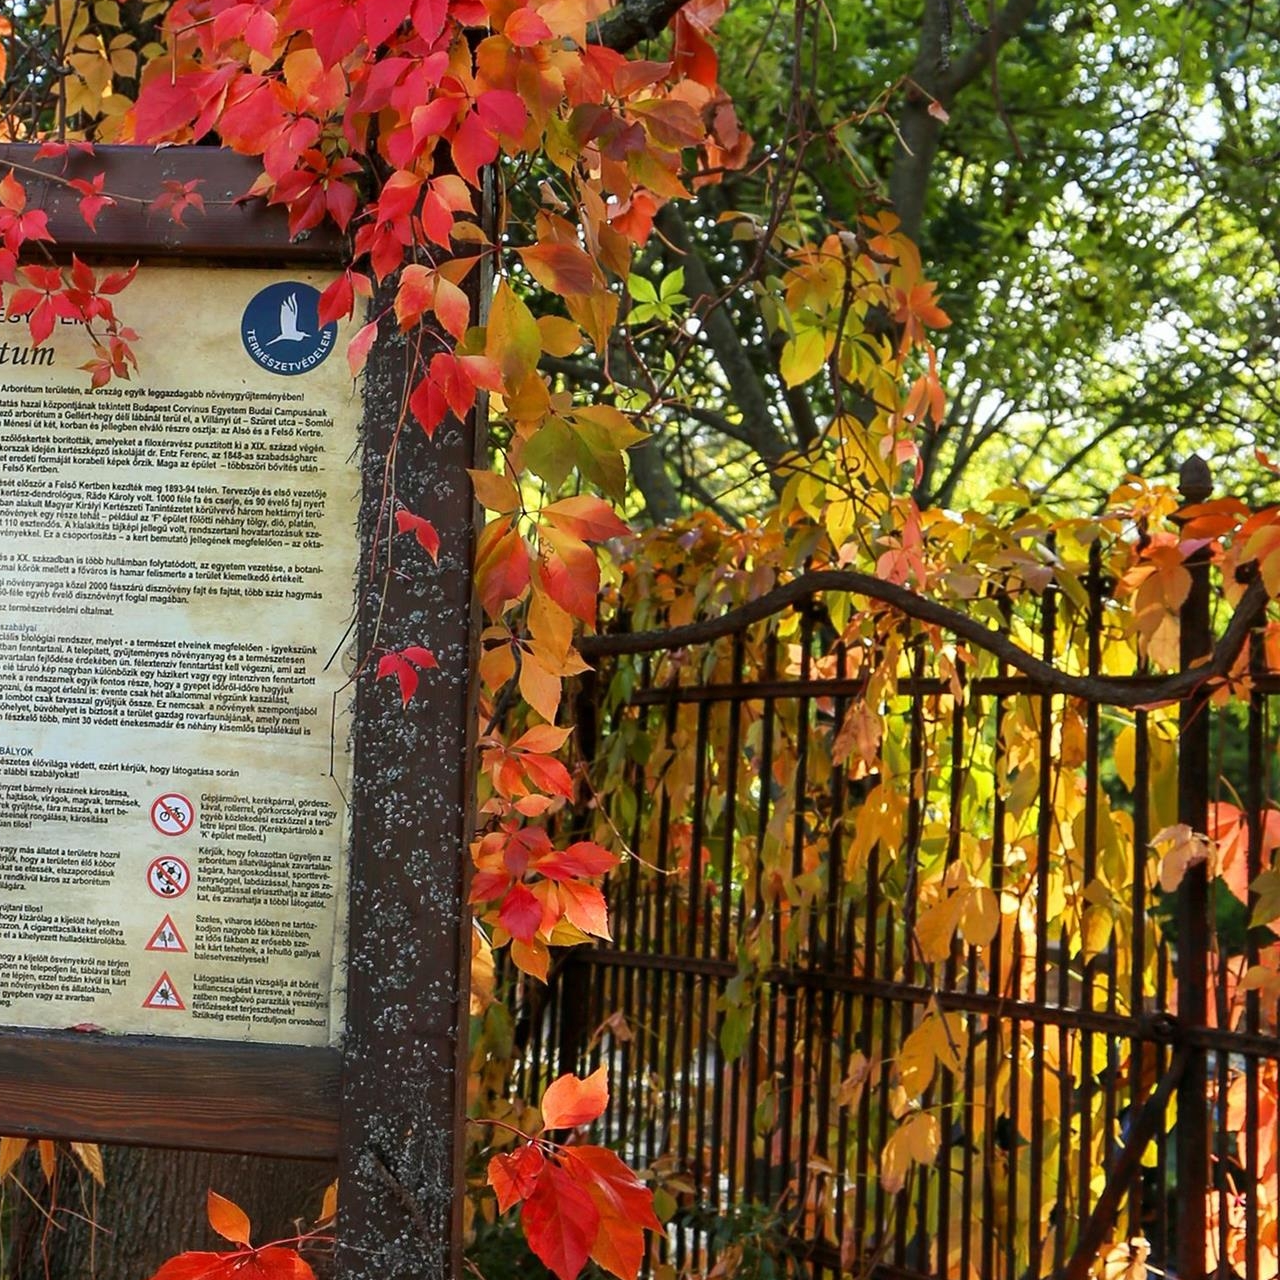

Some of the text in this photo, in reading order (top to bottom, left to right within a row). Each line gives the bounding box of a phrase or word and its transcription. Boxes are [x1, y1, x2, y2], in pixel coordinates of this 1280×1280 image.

[246, 328, 332, 371] TERMÉSZETVÉDELEM
[0, 385, 43, 393] Arborétum
[45, 386, 81, 395] területén,
[95, 388, 122, 397] ország
[124, 388, 145, 397] egyik
[147, 389, 204, 399] leggazdagabb
[79, 607, 114, 615] oltalmat.
[3, 768, 27, 776] alábbi
[29, 769, 80, 779] szabályokat!
[32, 759, 68, 770] élővilága
[69, 761, 96, 771] védett,
[98, 763, 118, 771] ezért
[120, 764, 147, 774] kérjük,
[149, 765, 170, 775] hogy
[172, 766, 214, 776] látogatása
[216, 769, 239, 777] során
[201, 794, 332, 808] Gépjárművel, kerékpárral, gördesz-
[13, 820, 32, 829] tilos!
[198, 847, 224, 857] Kérjük,
[226, 849, 246, 859] hogy
[247, 850, 287, 859] fokozottan
[288, 852, 321, 862] ügyeljen
[24, 904, 43, 913] tilos!
[194, 953, 269, 964] balesetveszélyesek!
[193, 974, 234, 985] Látogatása
[236, 977, 253, 985] után
[255, 978, 288, 989] vizsgálja
[298, 980, 319, 989] bőrét
[192, 1012, 224, 1022] Szükség
[252, 1015, 287, 1025] forduljon
[287, 1018, 326, 1026] orvoshoz!
